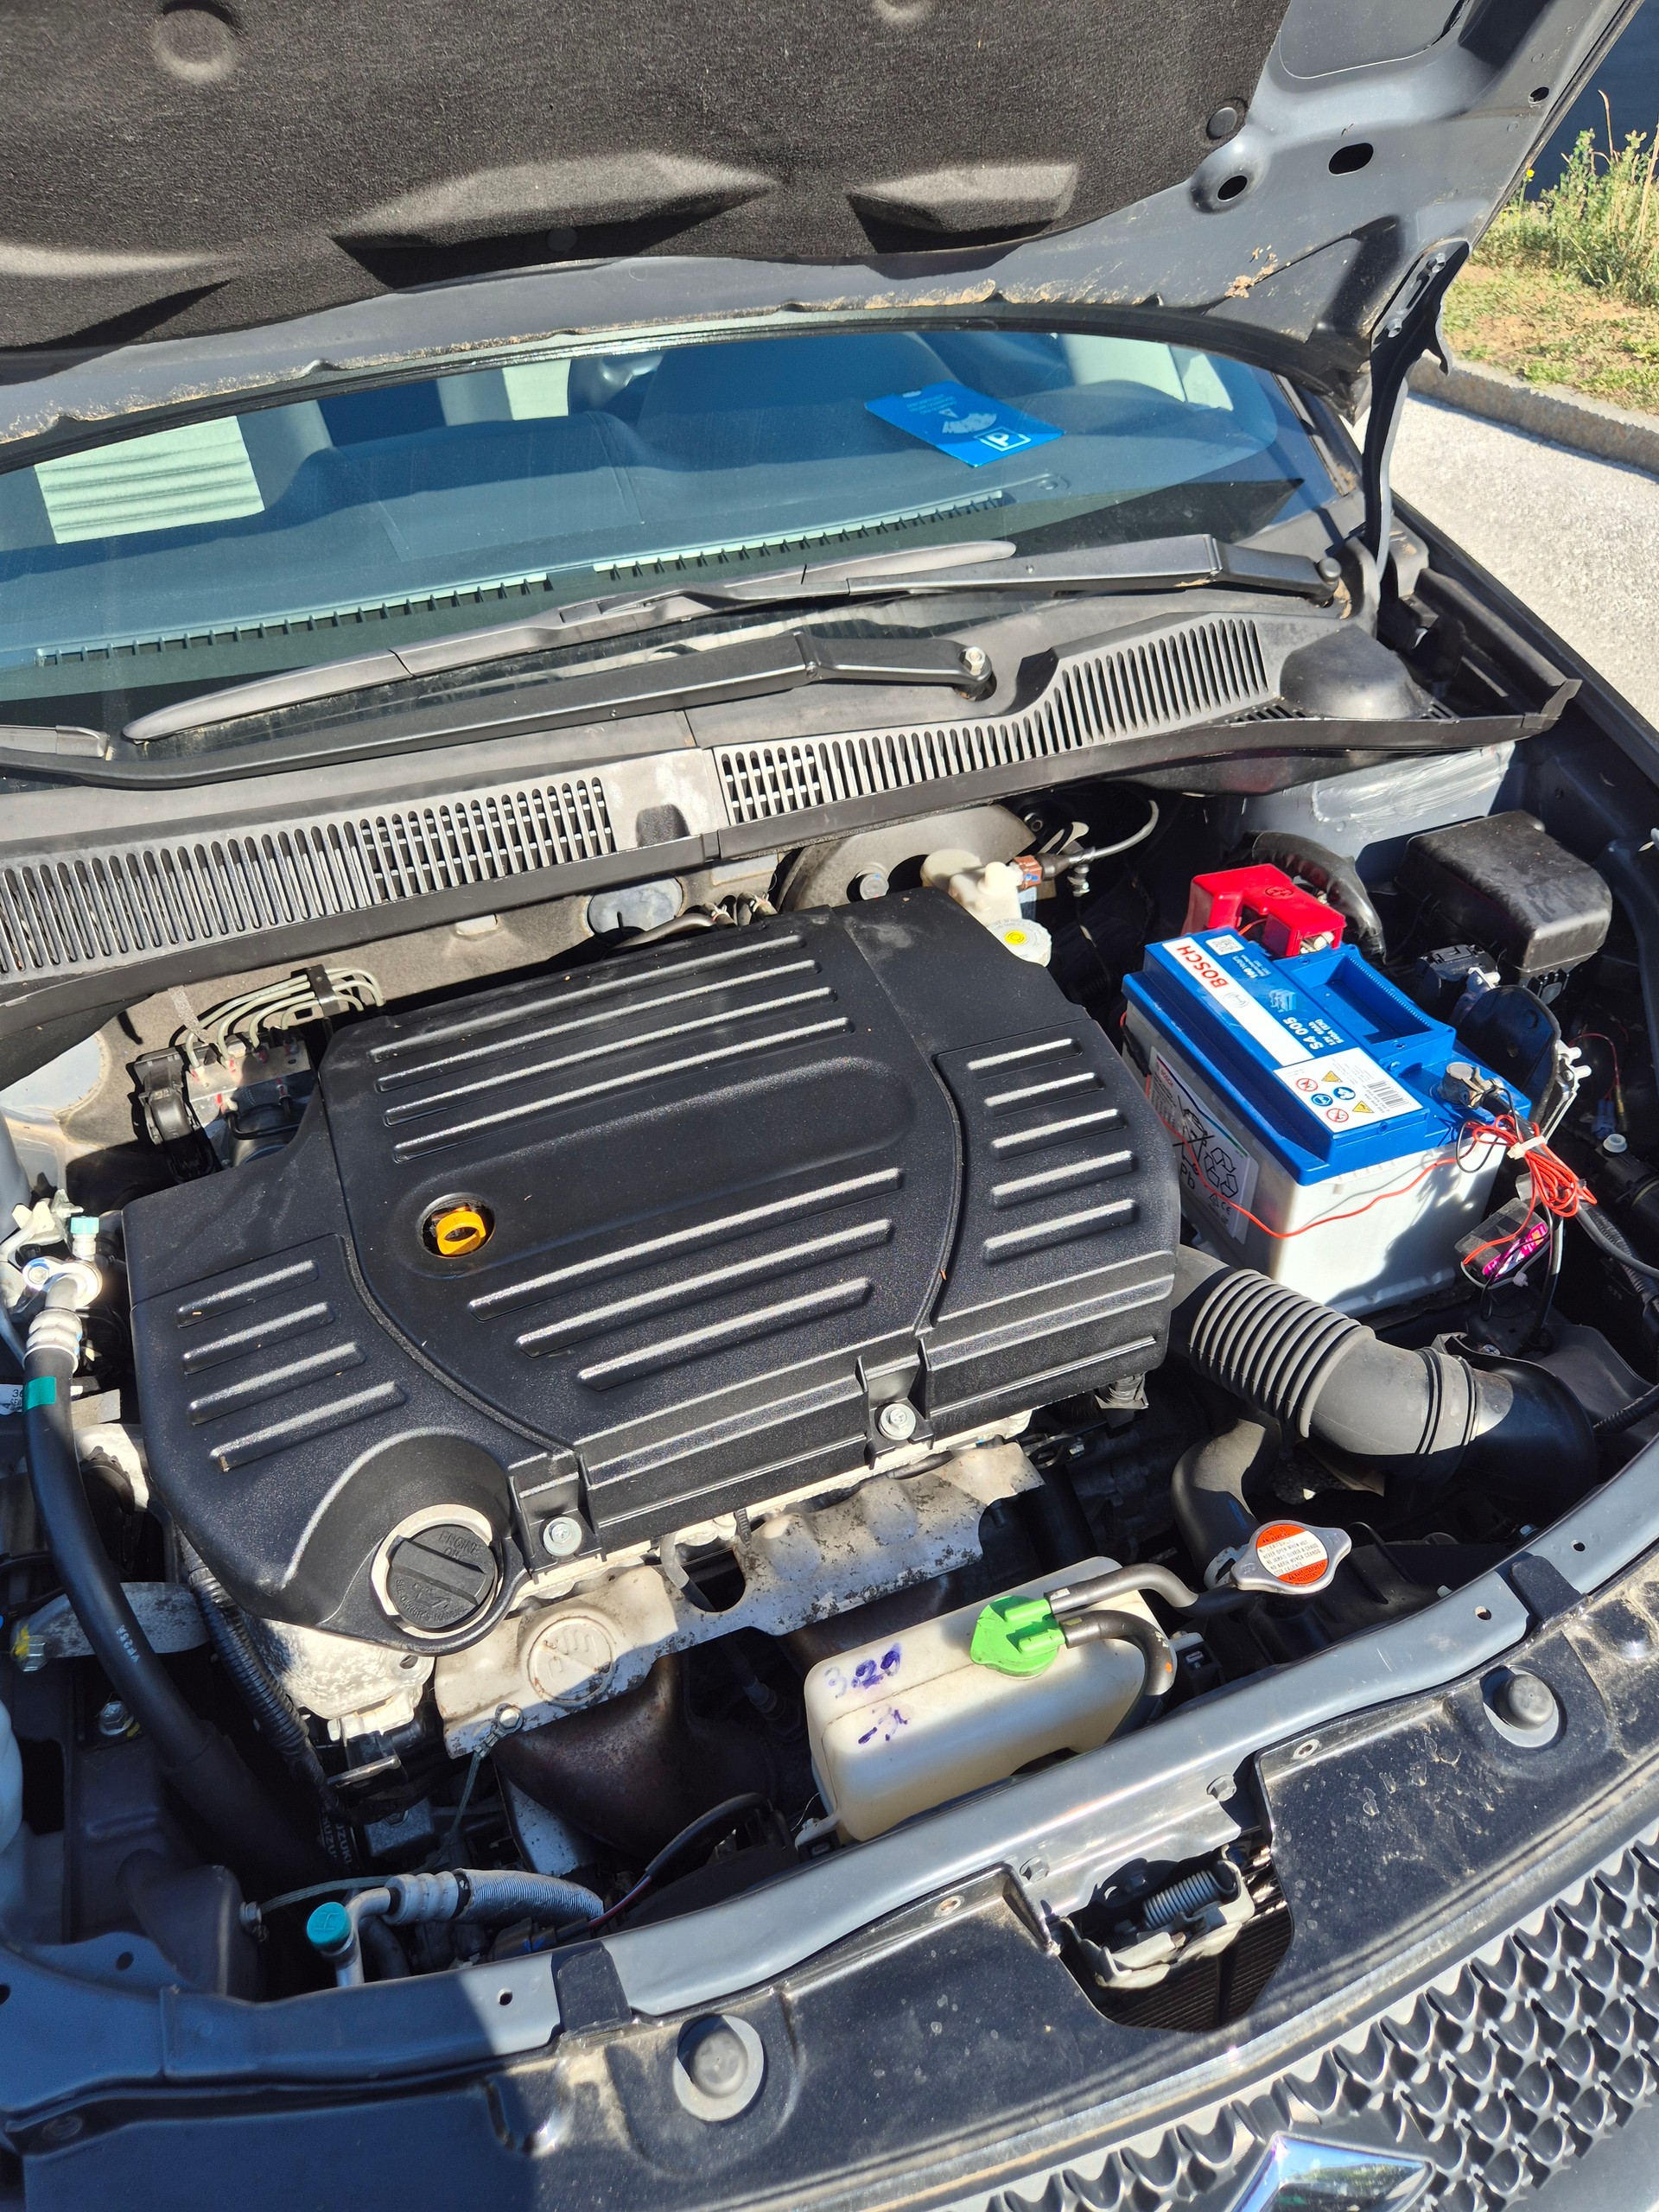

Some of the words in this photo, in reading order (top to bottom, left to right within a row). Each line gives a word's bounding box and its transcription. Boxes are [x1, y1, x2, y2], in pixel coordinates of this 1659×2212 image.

[988, 433, 1009, 447] P
[1176, 945, 1229, 988] BOSCH
[1282, 1016, 1309, 1036] 005
[1303, 1036, 1324, 1050] S4
[1322, 1036, 1338, 1046] 12V
[1180, 1163, 1196, 1190] Pb
[438, 1530, 480, 1554] ENGINE
